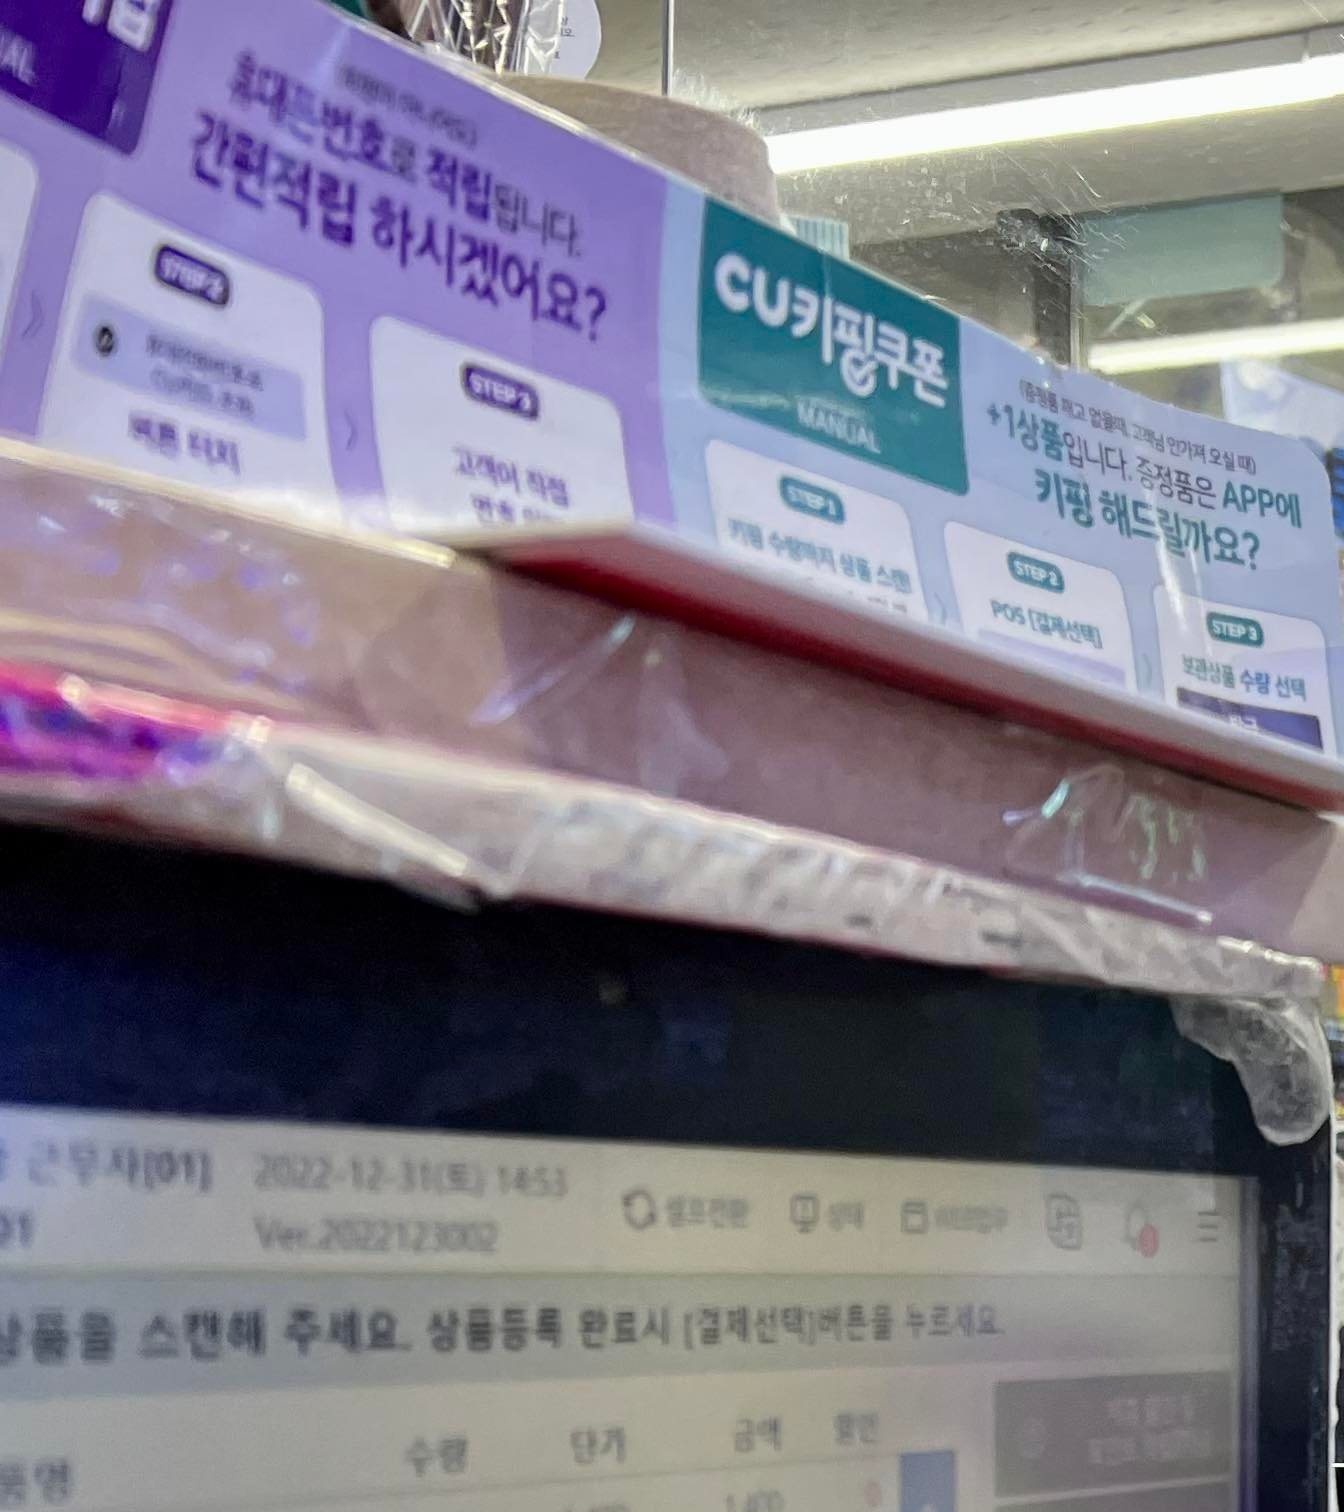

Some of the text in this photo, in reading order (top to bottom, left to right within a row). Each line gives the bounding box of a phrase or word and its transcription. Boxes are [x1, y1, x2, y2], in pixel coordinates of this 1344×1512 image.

[369, 199, 610, 343] 하시겠어요?
[714, 253, 948, 407] CU키핑쿠폰
[986, 401, 1132, 482] +1상품입니다.
[1136, 455, 1217, 511] 증정품은
[1222, 478, 1303, 529] APP에
[1033, 467, 1095, 528] 키핑
[1097, 489, 1261, 571] 해드릴까요?
[990, 599, 1026, 626] POS
[1239, 668, 1271, 696] 수량
[1274, 675, 1308, 701] 선택
[139, 1308, 267, 1363] 스캔해
[283, 1306, 413, 1357] 주세요.
[426, 1305, 563, 1355] 상품등록
[577, 1303, 671, 1351] 완료시
